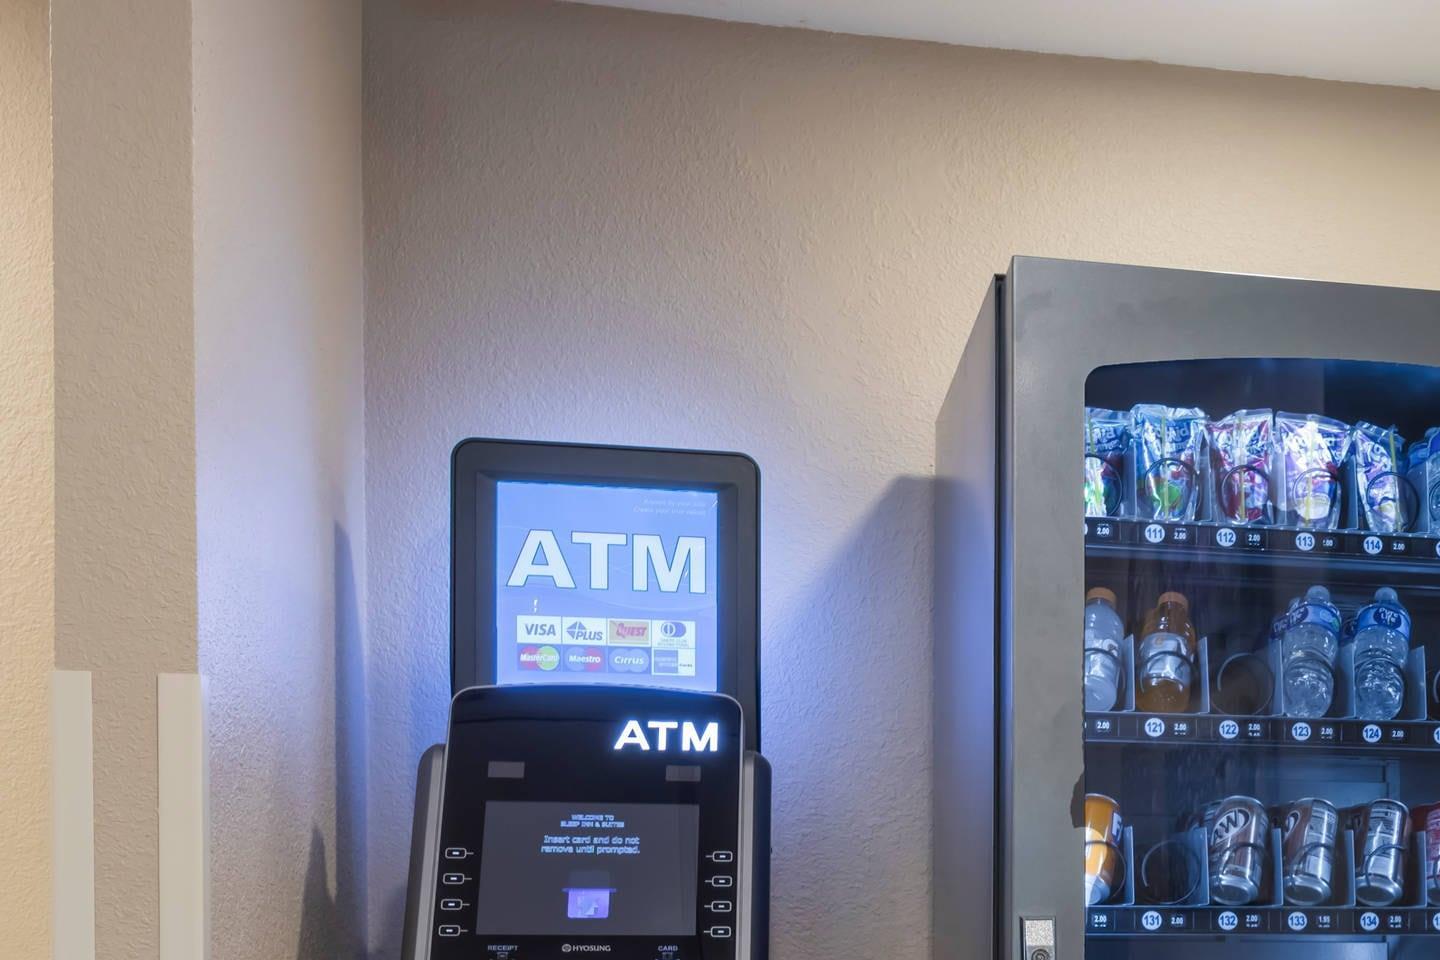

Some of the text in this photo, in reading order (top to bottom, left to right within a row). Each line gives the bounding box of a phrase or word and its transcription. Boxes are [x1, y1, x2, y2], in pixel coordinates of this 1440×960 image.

[1096, 527, 1110, 535] 2.00
[1146, 527, 1187, 540] 111 2.00
[1217, 531, 1235, 543] 112
[1296, 535, 1313, 547] 113
[1365, 540, 1405, 551] 114 2.00
[506, 528, 708, 595] ATM
[525, 623, 557, 636] VISA
[616, 622, 648, 638] QUEST
[576, 631, 603, 641] PLUS
[520, 653, 560, 663] MasterCard
[568, 654, 601, 664] Maestro
[614, 656, 645, 665] Cirrus
[1096, 721, 1110, 730] 2.00
[1146, 721, 1163, 733] 121
[1220, 724, 1237, 735] 122
[613, 720, 719, 752] ATM
[1293, 726, 1333, 737] 123 2.00
[1364, 728, 1404, 739] 124 2.00
[543, 835, 570, 843] Insert
[593, 836, 610, 844] and
[611, 836, 623, 844] do
[625, 836, 640, 844] not
[576, 845, 595, 853] until
[596, 845, 640, 855] prompted.
[1094, 915, 1107, 923] 2.00
[1143, 915, 1184, 926] 131 2.00
[1220, 914, 1258, 926] 132 2.00
[1289, 916, 1306, 927] 133
[1361, 916, 1378, 927] 134
[572, 944, 611, 952] HYOSUNG
